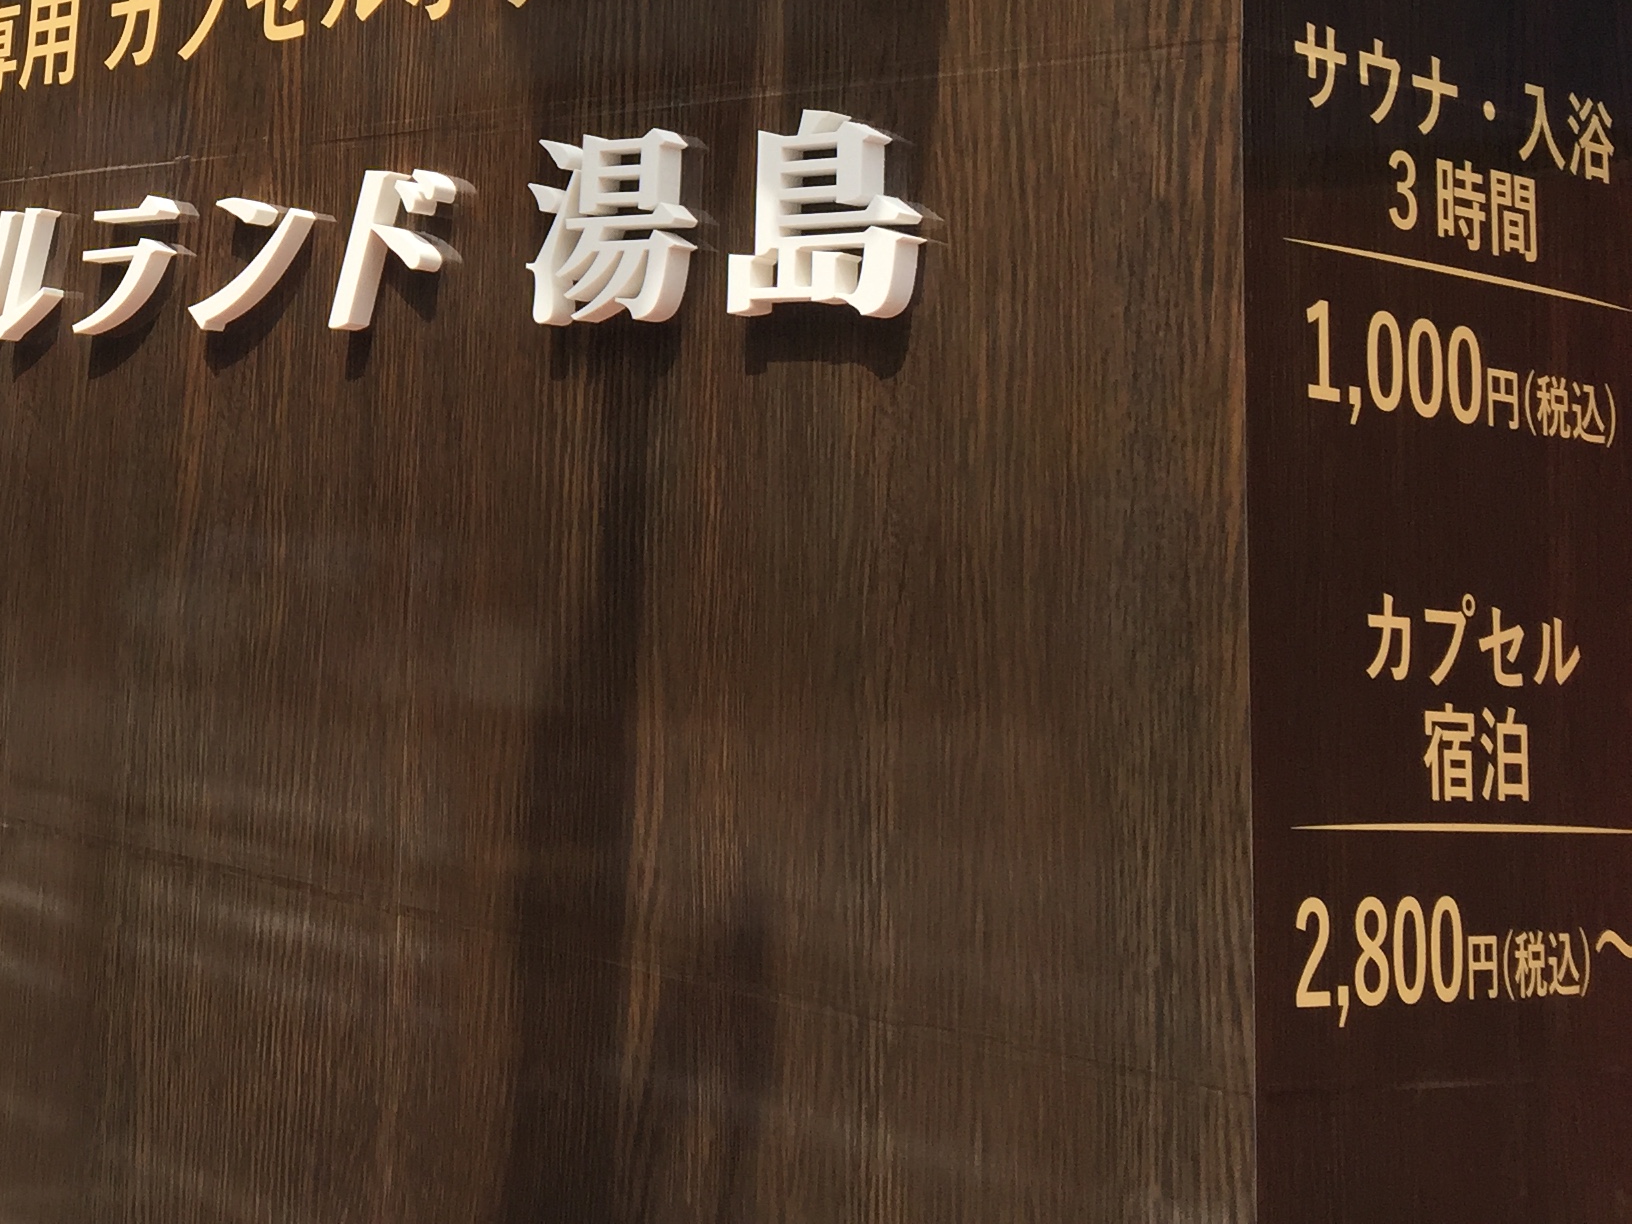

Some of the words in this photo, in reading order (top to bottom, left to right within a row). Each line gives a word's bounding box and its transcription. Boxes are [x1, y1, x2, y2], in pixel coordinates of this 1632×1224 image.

[1294, 21, 1614, 185] サウナ・入浴
[527, 108, 930, 327] 湯島
[1365, 592, 1581, 688] カプセル
[1423, 702, 1531, 803] 宿泊
